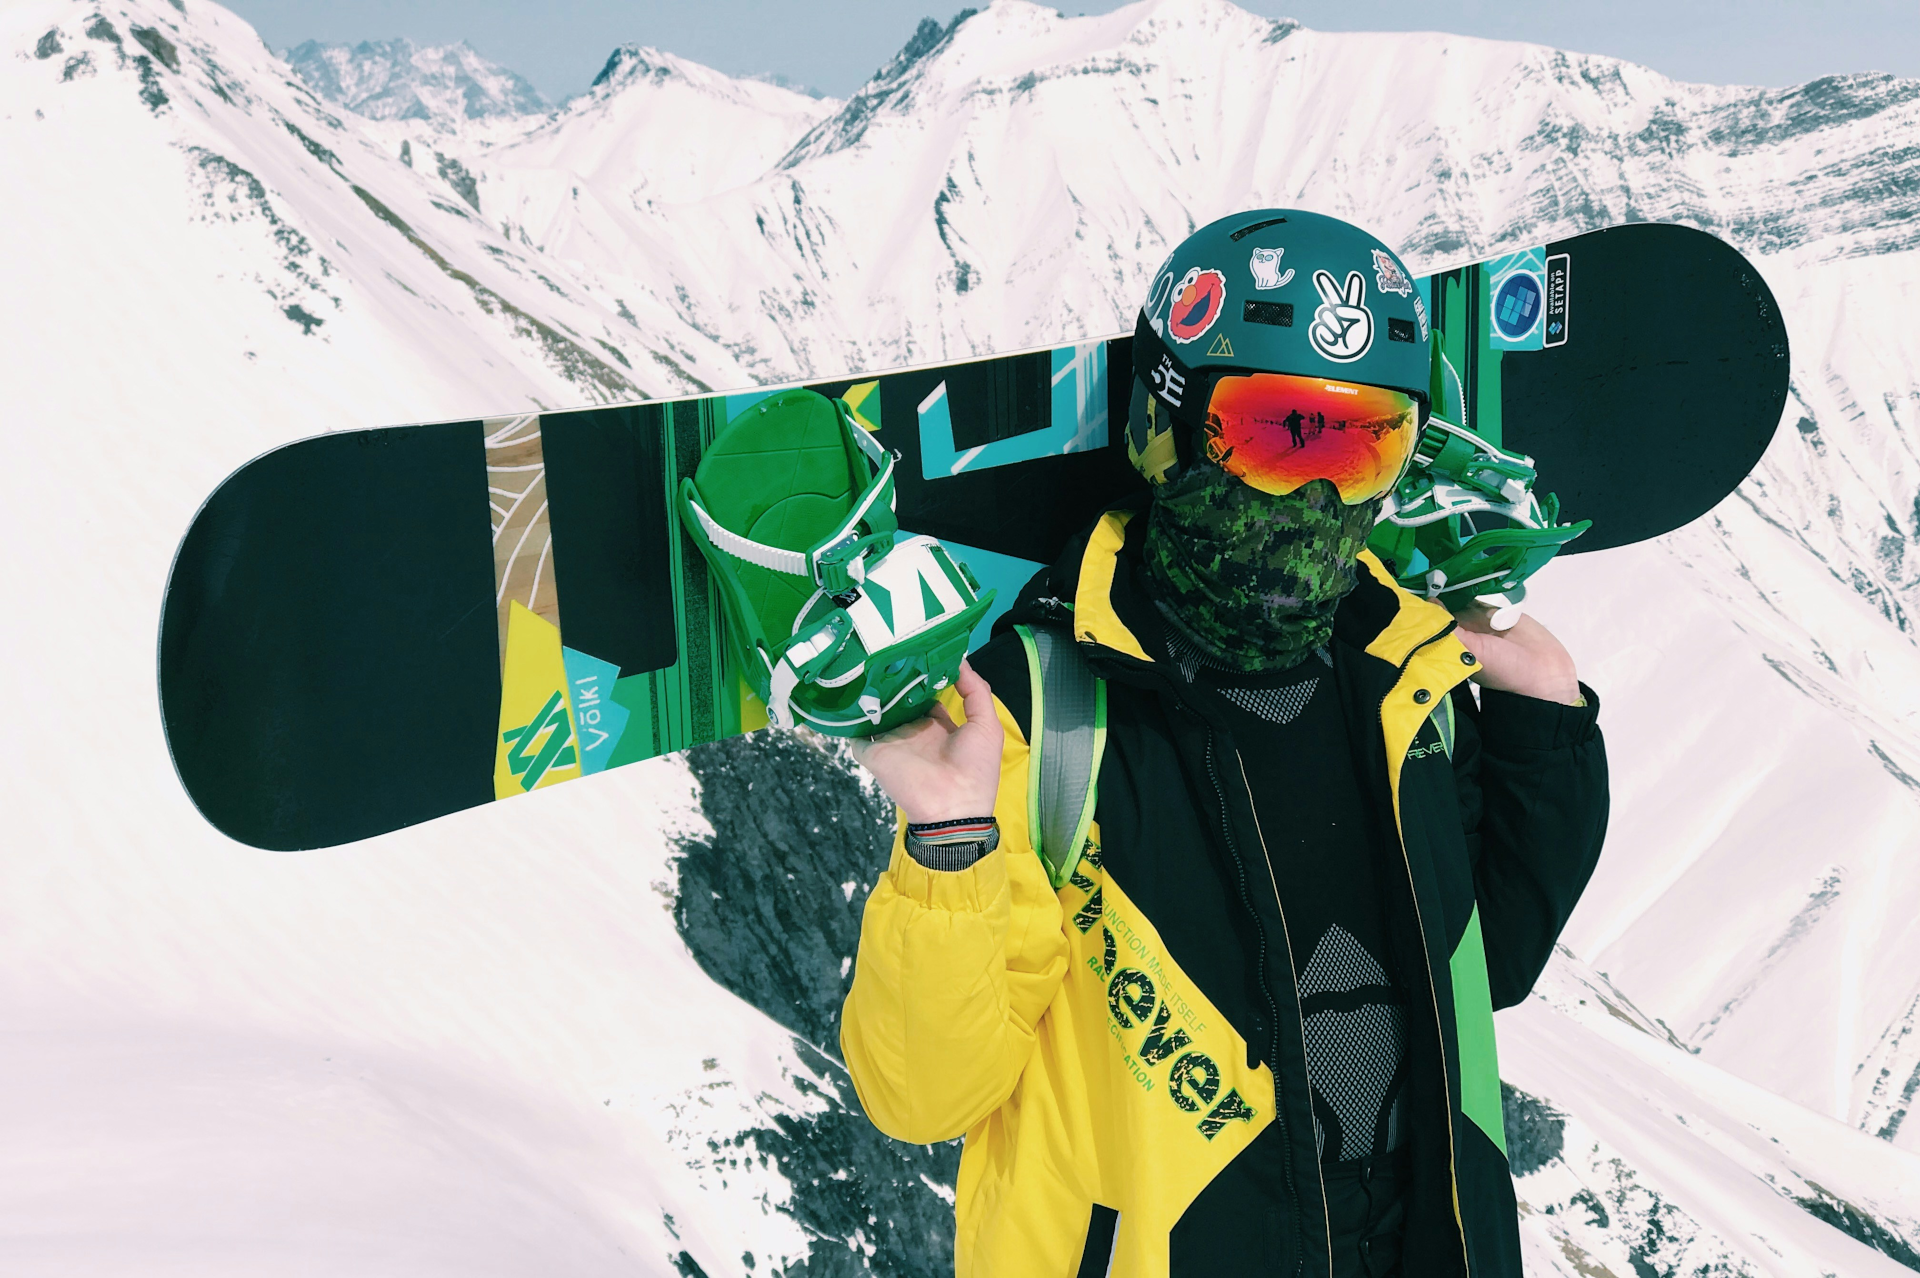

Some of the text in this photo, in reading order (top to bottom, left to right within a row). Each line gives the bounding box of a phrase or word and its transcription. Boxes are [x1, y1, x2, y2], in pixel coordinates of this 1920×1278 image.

[1555, 269, 1565, 314] SETAPP
[1147, 955, 1173, 997] MADE
[1168, 991, 1207, 1035] ITSELF
